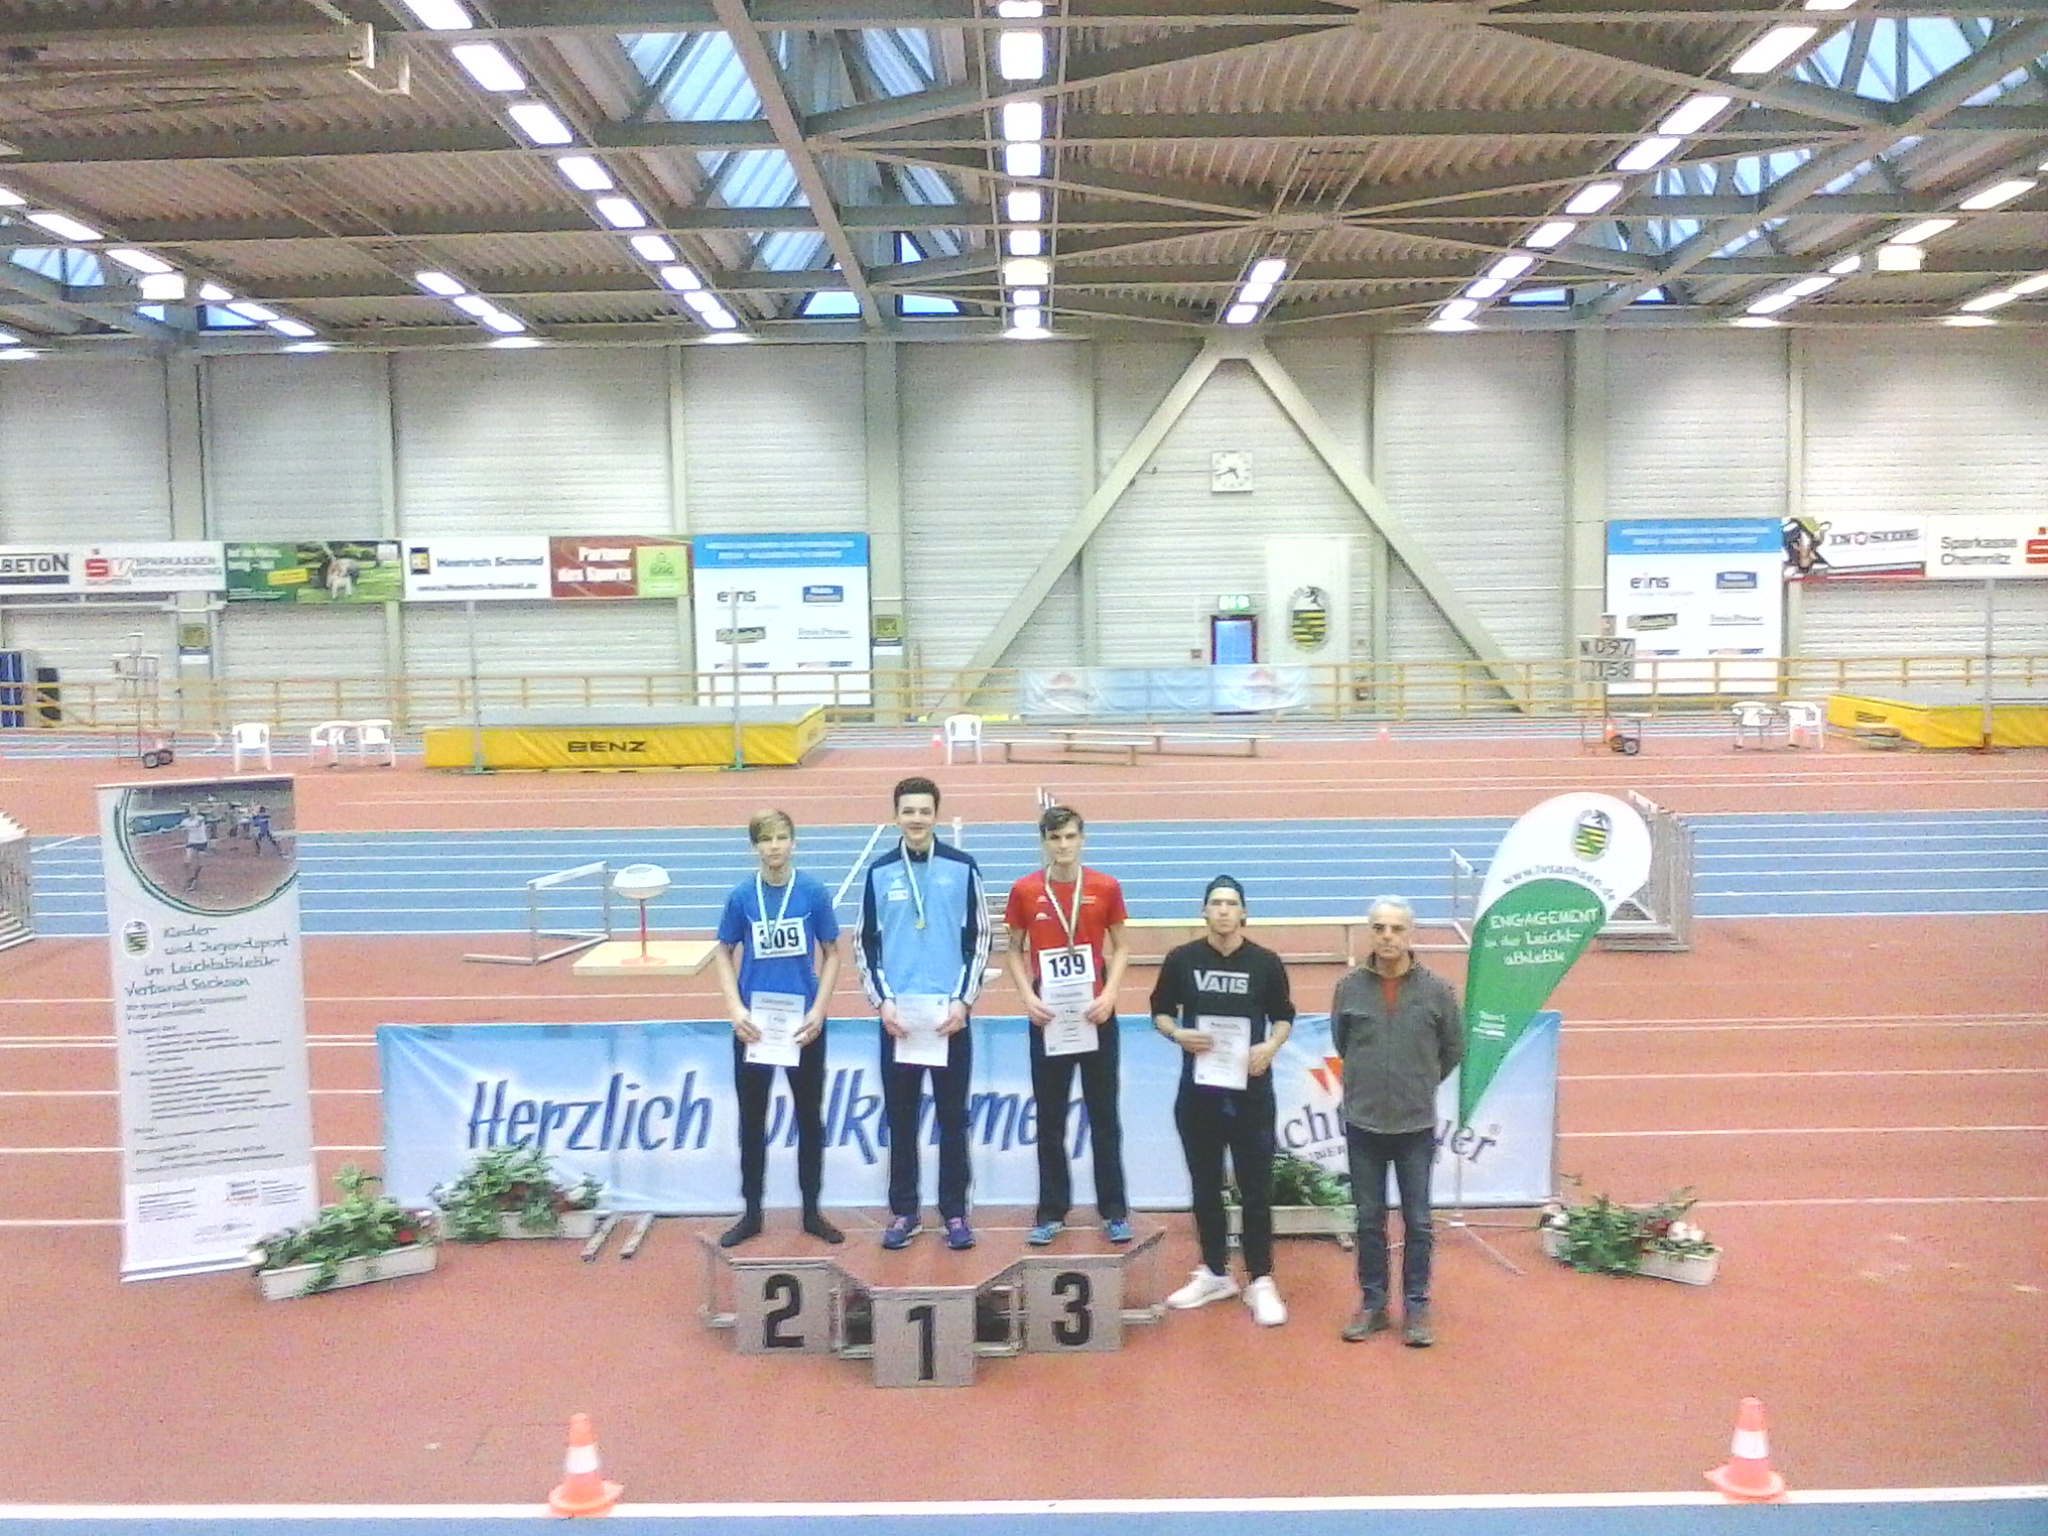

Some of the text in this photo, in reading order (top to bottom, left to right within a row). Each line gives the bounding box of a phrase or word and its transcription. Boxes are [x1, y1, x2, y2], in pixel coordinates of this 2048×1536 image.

[1941, 536, 2017, 552] Sparkasse
[717, 587, 756, 603] ens
[567, 741, 647, 753] BENZ
[1489, 908, 1600, 929] ENGAGEMENT
[1048, 953, 1087, 978] 139
[1193, 969, 1250, 994] VANS
[467, 1071, 714, 1152] Herzlich
[762, 1272, 805, 1348] 2
[1050, 1271, 1093, 1346] 3
[906, 1304, 937, 1381] 1
